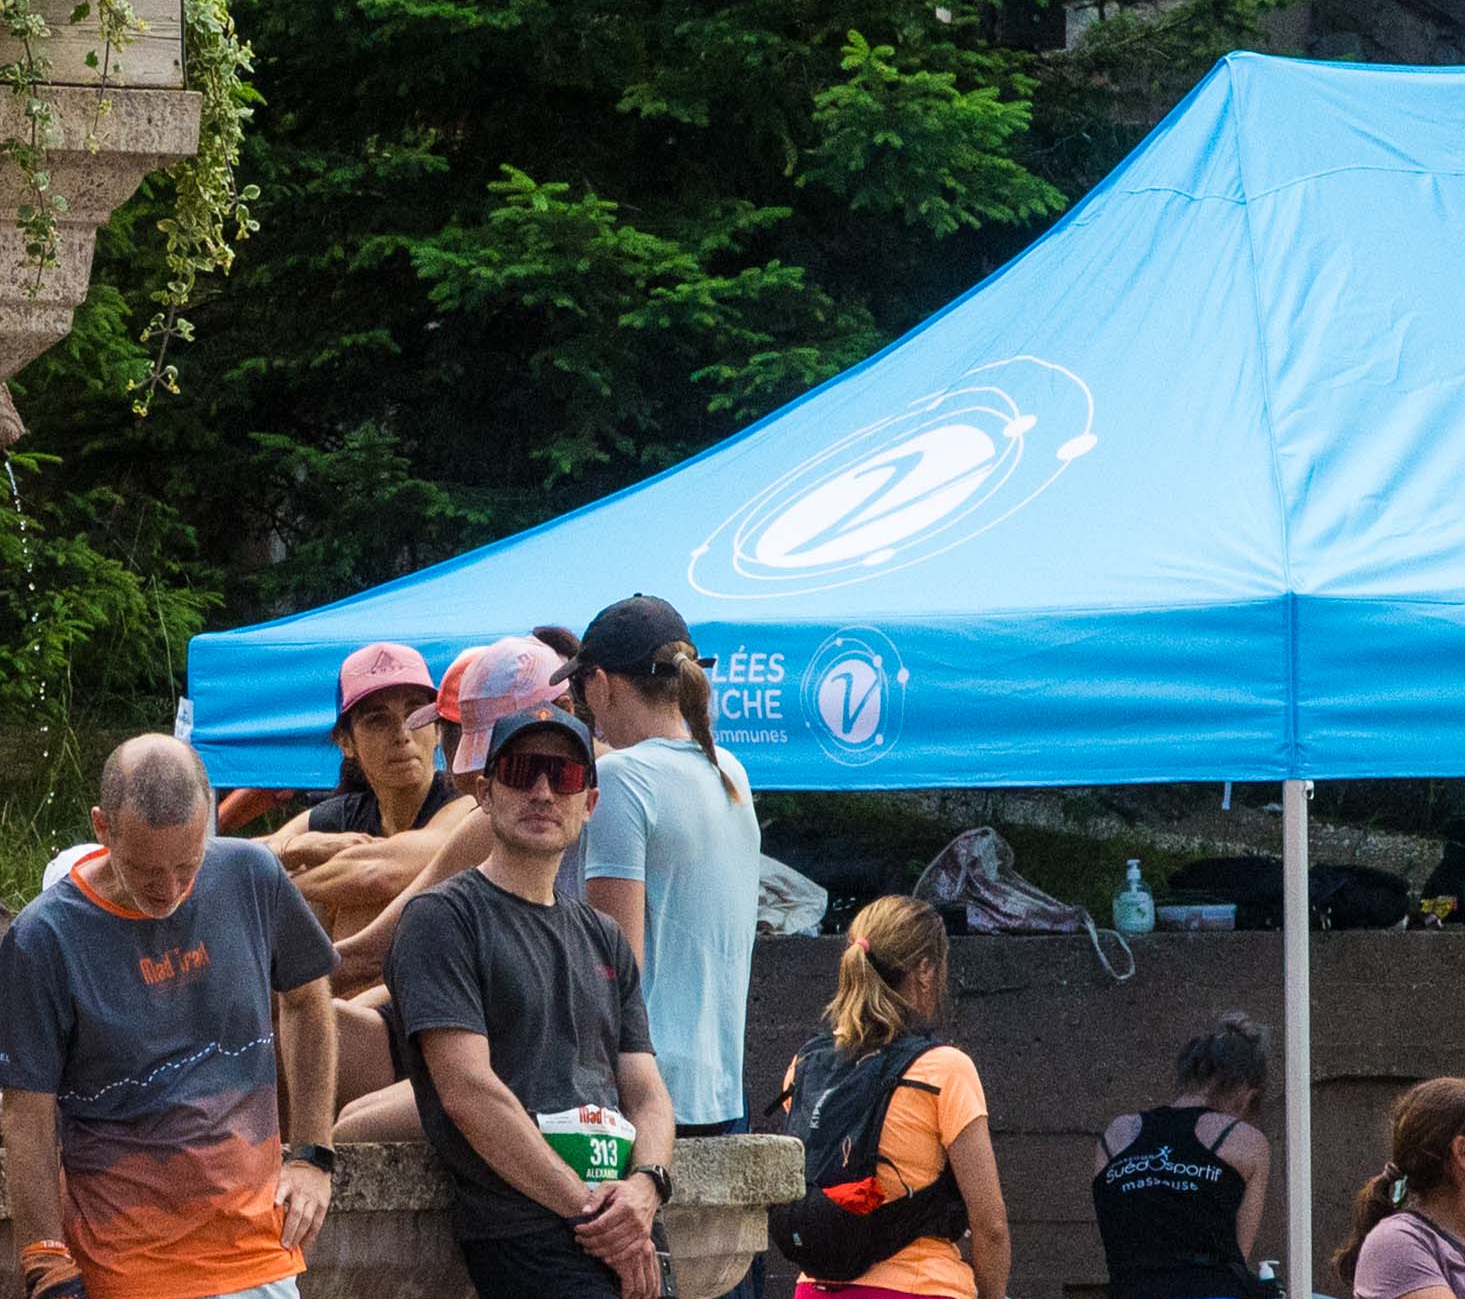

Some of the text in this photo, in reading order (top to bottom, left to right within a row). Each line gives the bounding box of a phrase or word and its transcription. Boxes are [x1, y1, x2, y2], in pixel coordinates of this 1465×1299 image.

[712, 644, 785, 683] LÉES
[713, 728, 788, 745] ommunes
[590, 1137, 618, 1167] 313
